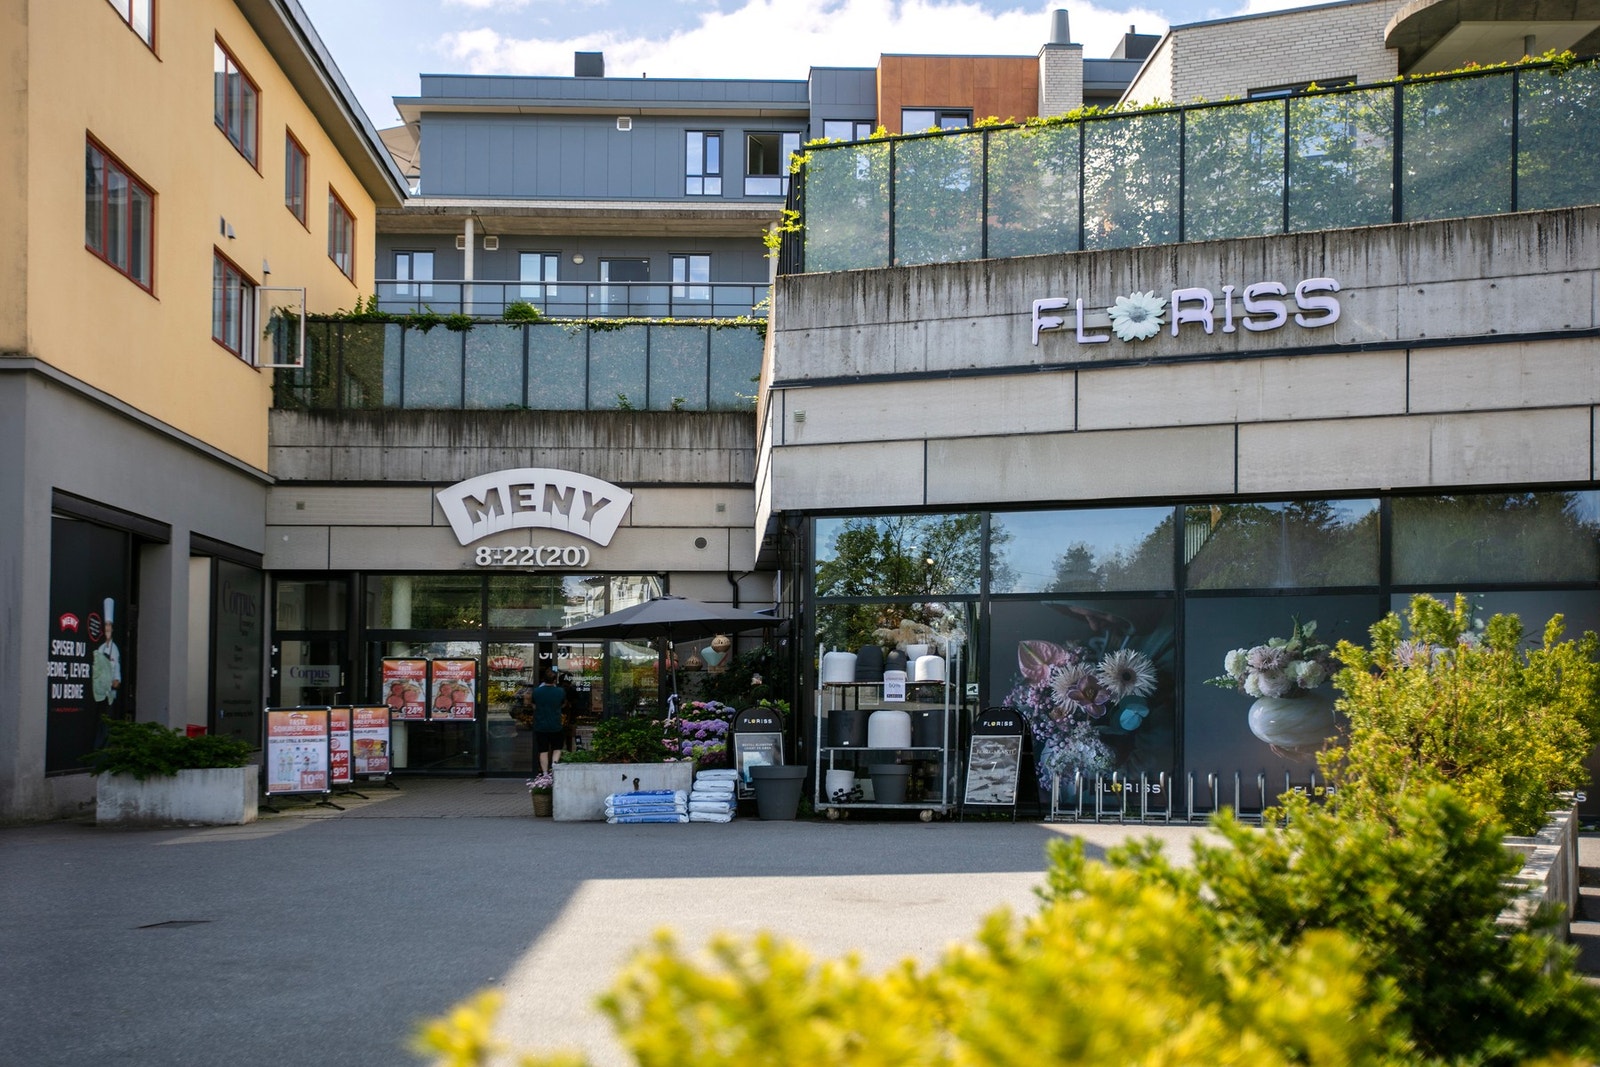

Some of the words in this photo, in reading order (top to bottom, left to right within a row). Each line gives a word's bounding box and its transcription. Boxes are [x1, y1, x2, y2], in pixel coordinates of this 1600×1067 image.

[461, 483, 612, 524] MENY
[475, 545, 591, 567] 8-22(20)
[51, 640, 74, 656] SPISER
[76, 642, 86, 657] DU
[70, 662, 90, 678] LEVER
[290, 666, 330, 684] Corpus
[52, 683, 62, 699] DU
[63, 684, 84, 699] BEDRE
